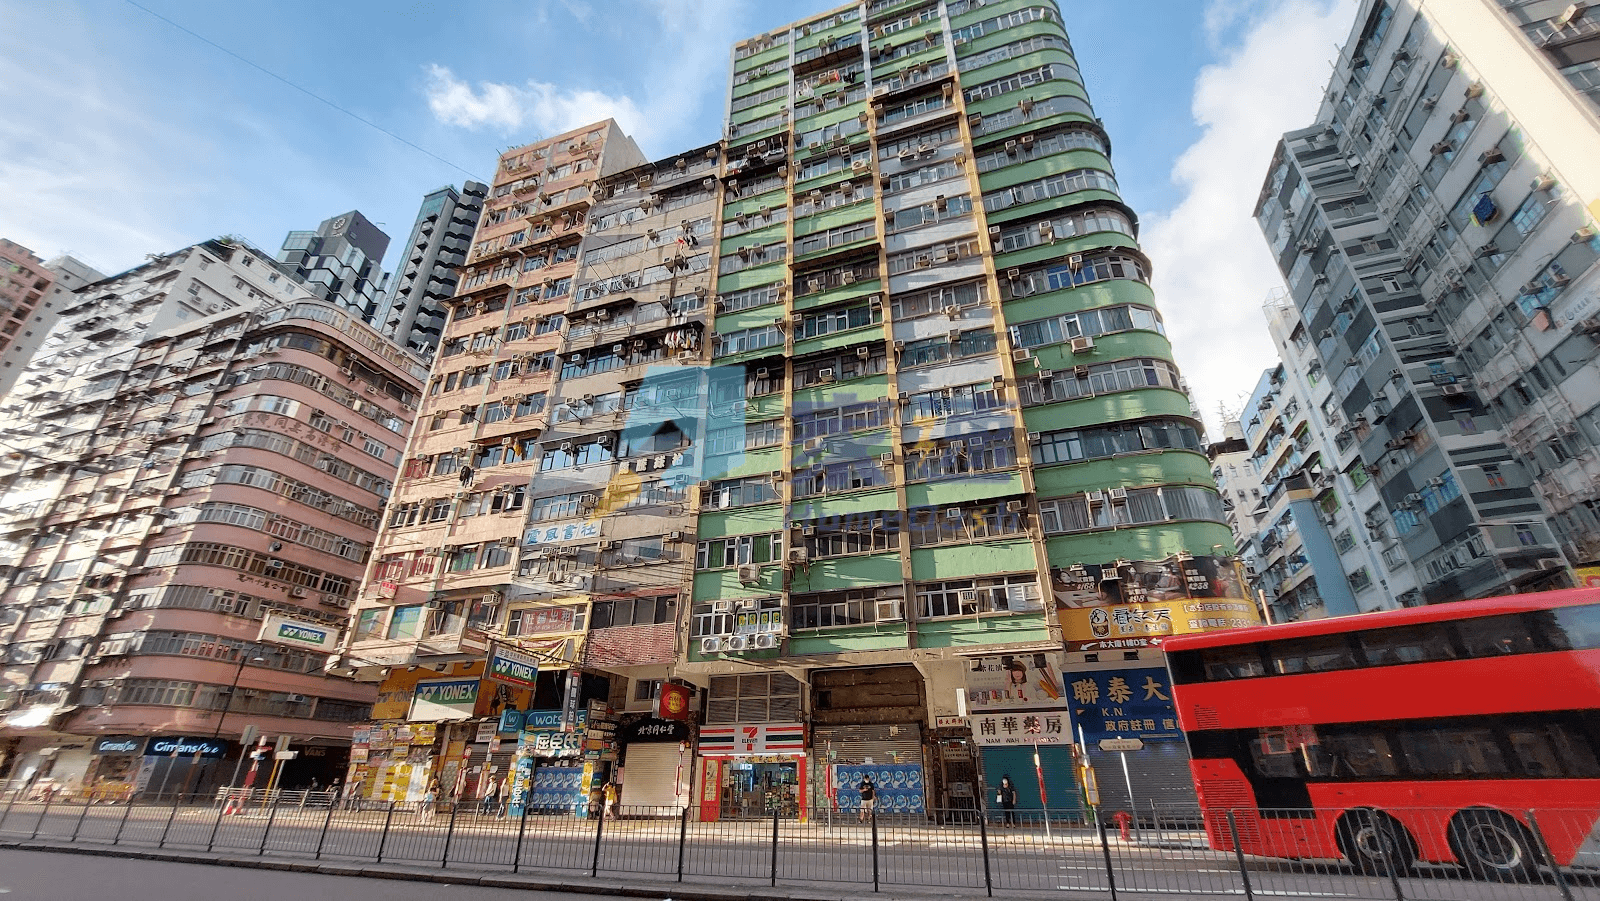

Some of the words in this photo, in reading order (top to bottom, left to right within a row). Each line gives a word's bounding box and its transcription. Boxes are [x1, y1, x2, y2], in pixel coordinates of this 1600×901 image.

[299, 629, 322, 641] YONEX
[511, 661, 534, 680] YONEX
[439, 684, 475, 700] YONEX
[638, 724, 675, 735] 北京同仁堂
